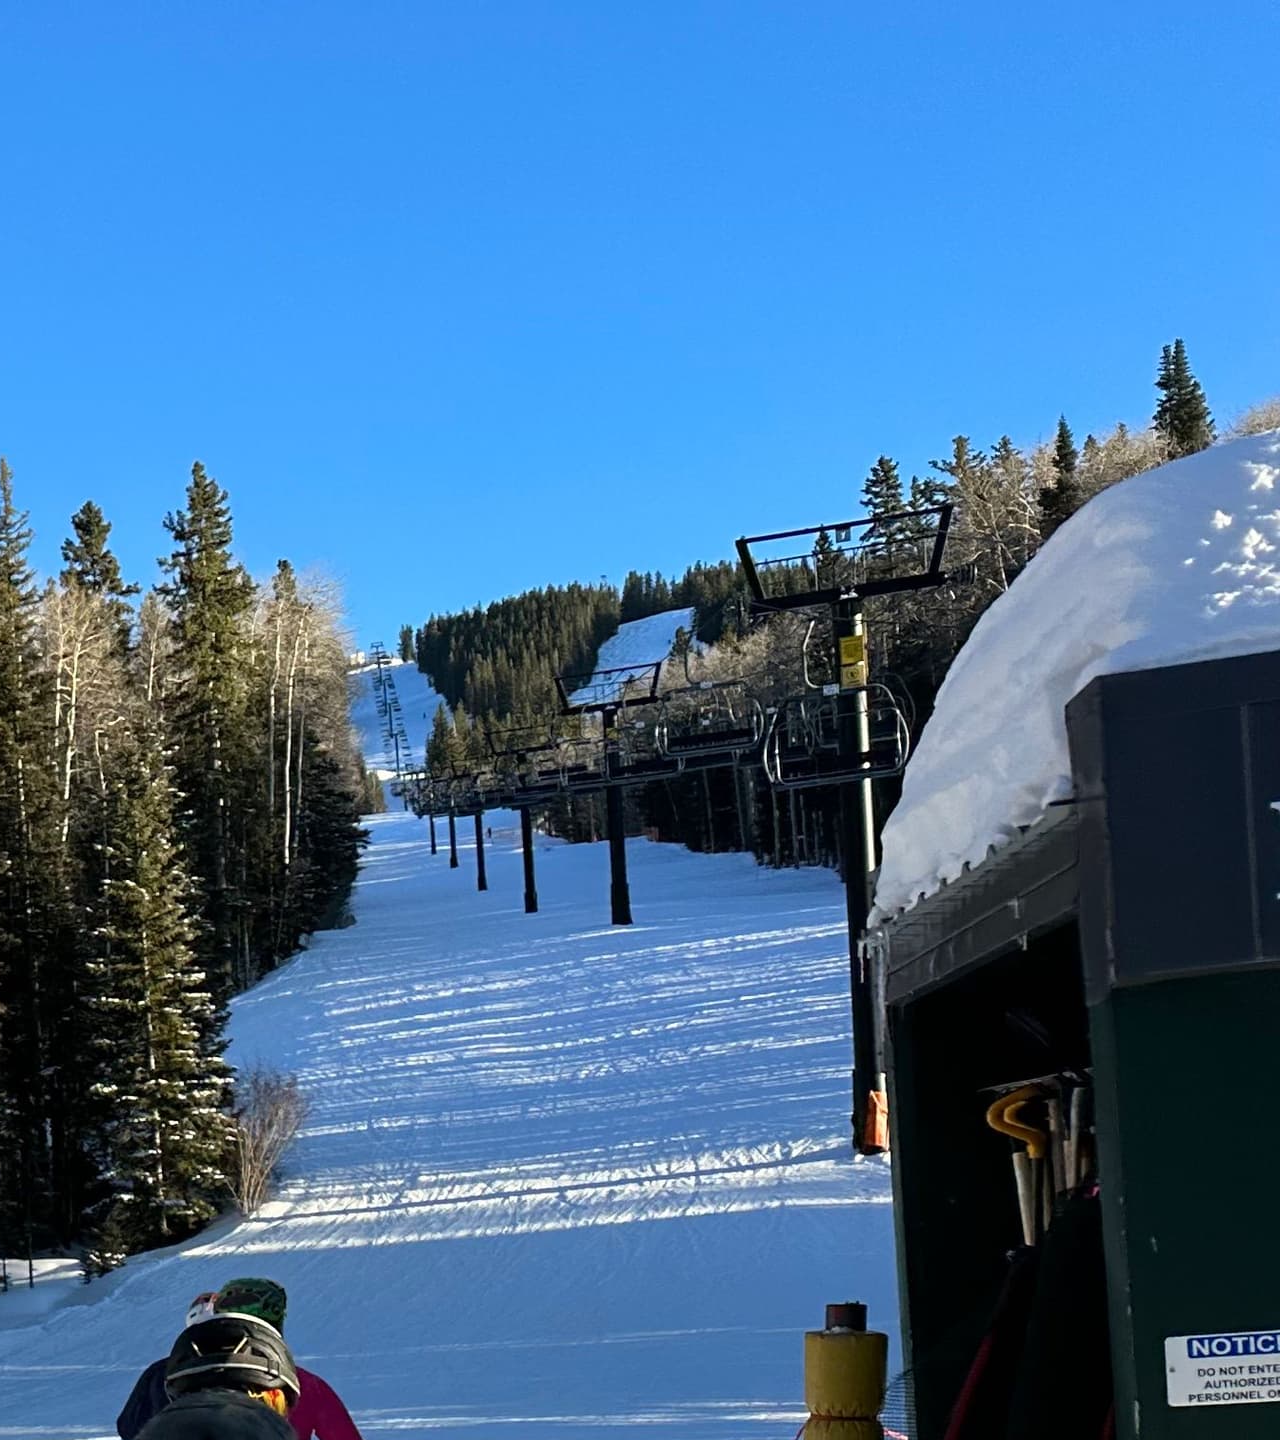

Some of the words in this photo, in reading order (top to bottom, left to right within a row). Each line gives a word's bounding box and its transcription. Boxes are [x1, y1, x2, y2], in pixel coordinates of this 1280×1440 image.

[1198, 1367, 1216, 1377] DO
[1220, 1366, 1245, 1376] NOT
[1189, 1390, 1265, 1402] PERSONNEL
